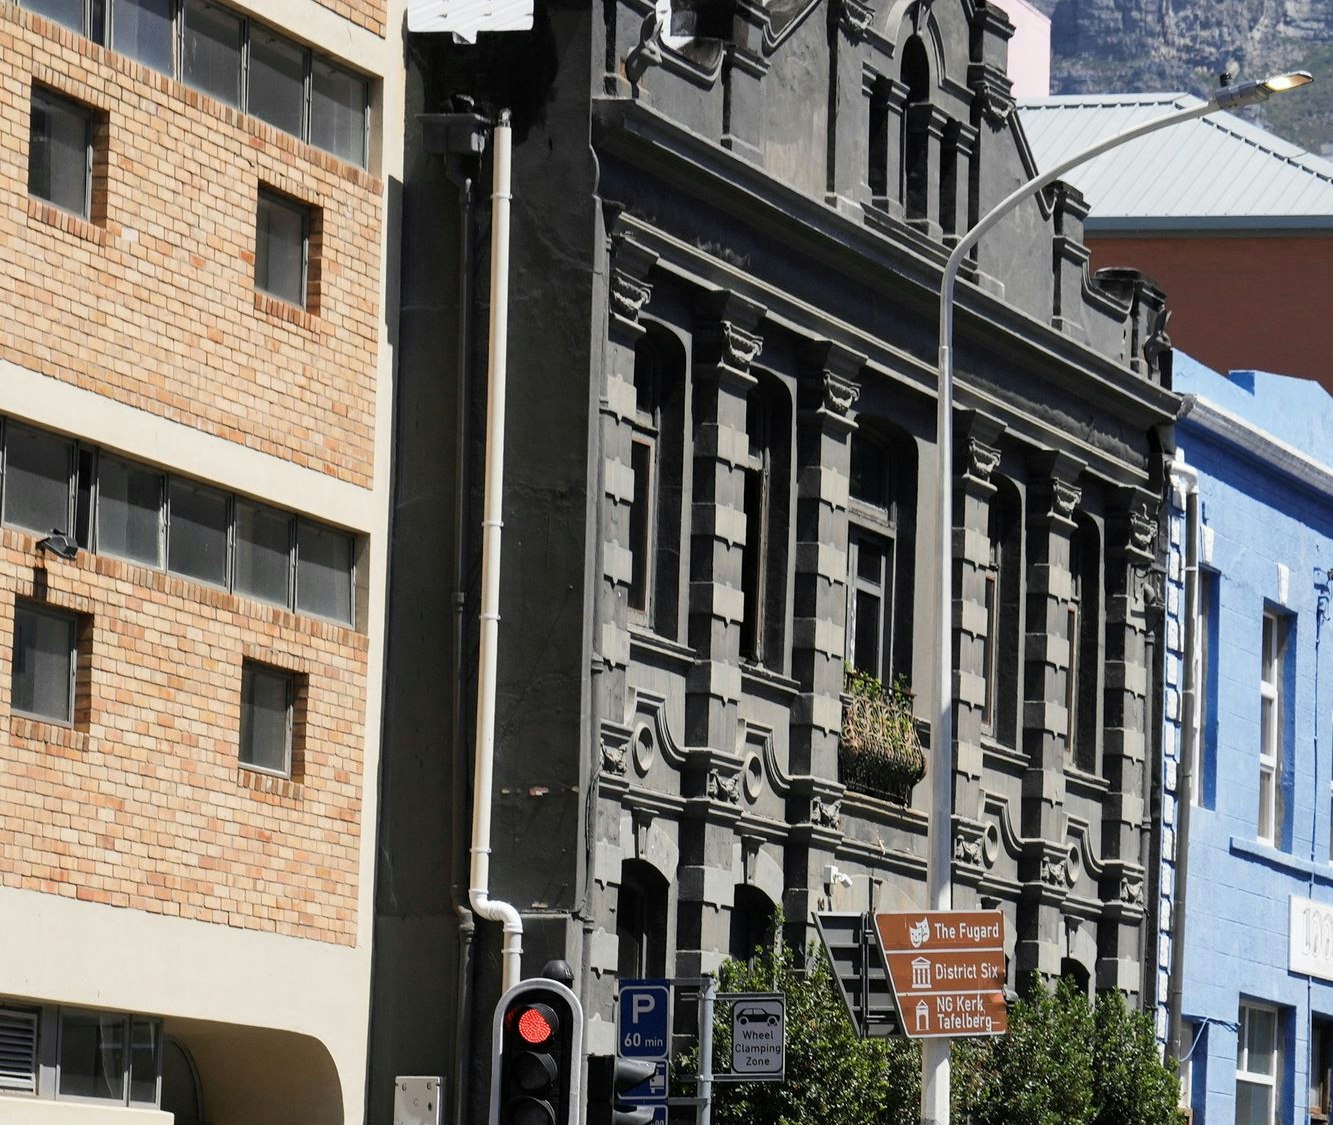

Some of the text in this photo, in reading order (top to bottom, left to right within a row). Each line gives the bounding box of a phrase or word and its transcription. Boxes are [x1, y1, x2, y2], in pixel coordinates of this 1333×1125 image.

[935, 922, 999, 941] The Fugard
[936, 962, 998, 979] District Six
[632, 994, 656, 1024] P
[937, 996, 953, 1012] NG
[938, 1013, 992, 1032] Tafelberg
[624, 1032, 663, 1047] 60 min
[742, 1030, 774, 1040] Wheel
[735, 1044, 781, 1056] Clamping
[746, 1057, 770, 1066] Zone
